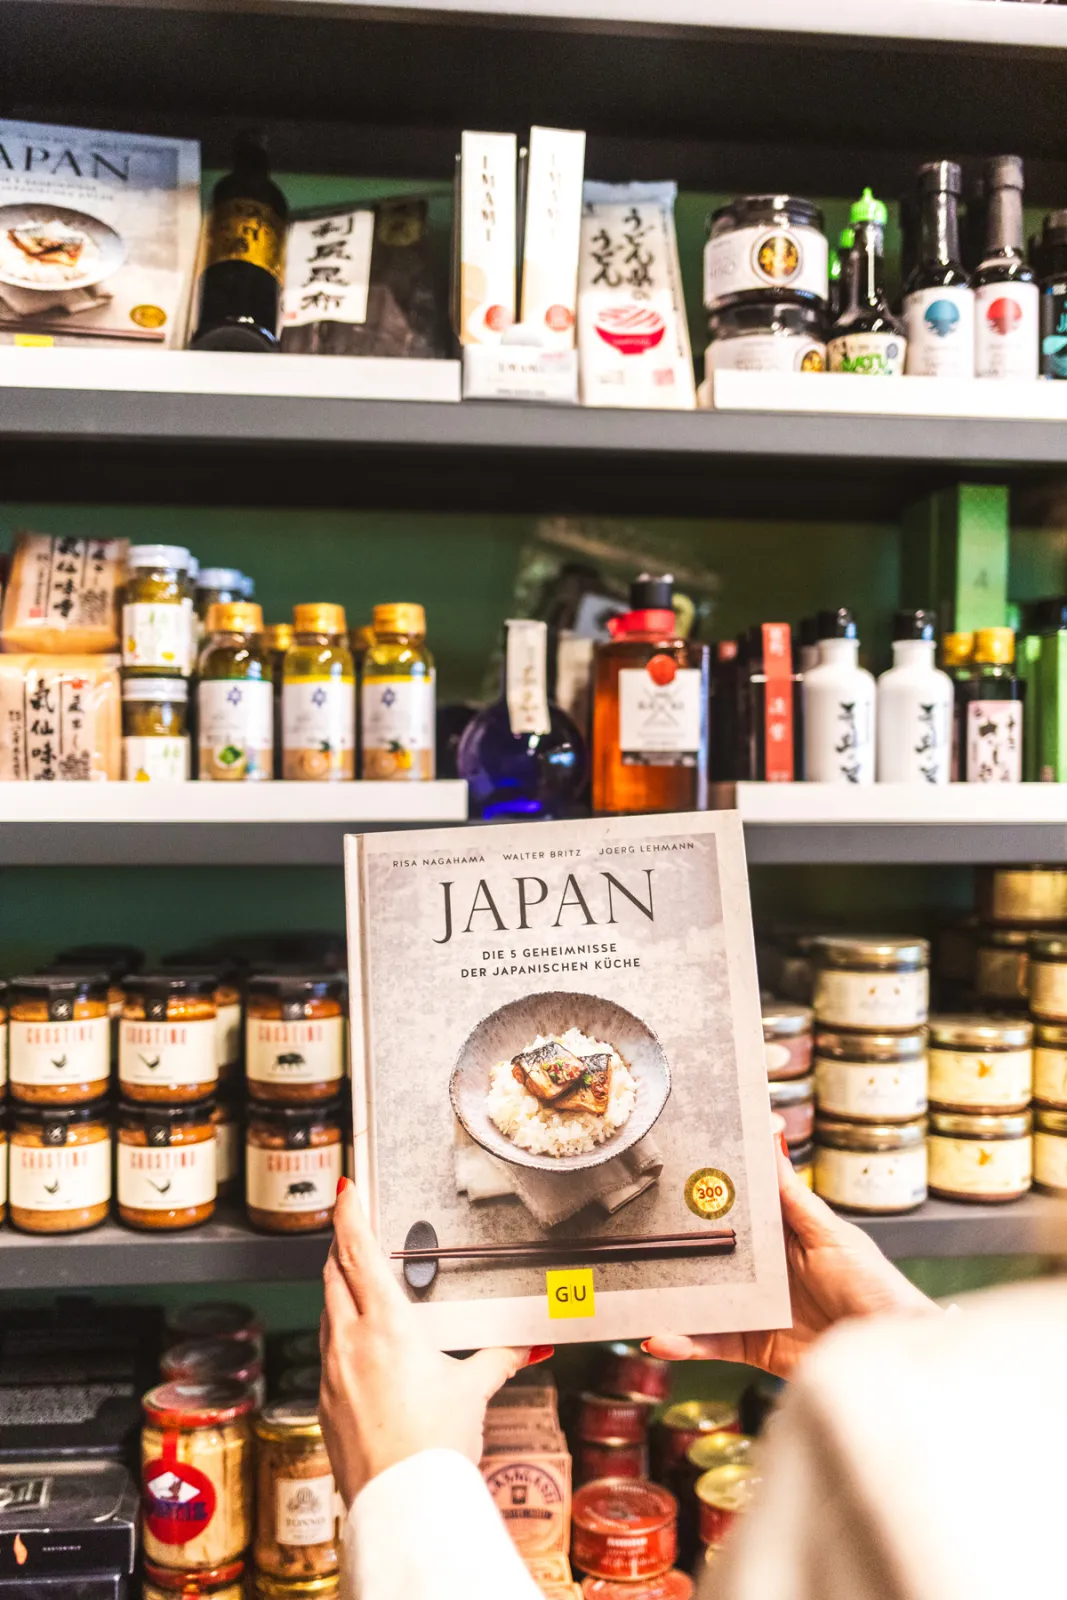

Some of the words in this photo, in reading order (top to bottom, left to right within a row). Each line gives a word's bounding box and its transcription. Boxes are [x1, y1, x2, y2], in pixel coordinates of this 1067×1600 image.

[392, 859, 417, 868] RISA
[422, 855, 486, 866] NAGAHAMA
[502, 851, 545, 861] WALTER
[550, 849, 582, 858] BRITZ
[598, 845, 635, 855] JOERG
[639, 842, 695, 853] LEHMANN
[432, 868, 655, 944] JAPAN
[482, 950, 505, 960] DIE
[510, 949, 517, 959] 5
[522, 943, 617, 958] GEHEIMNISSE
[461, 968, 487, 978] DER
[492, 961, 588, 976] JAPANISCHEN
[594, 956, 641, 970] KÜCHE
[697, 1185, 723, 1199] 300
